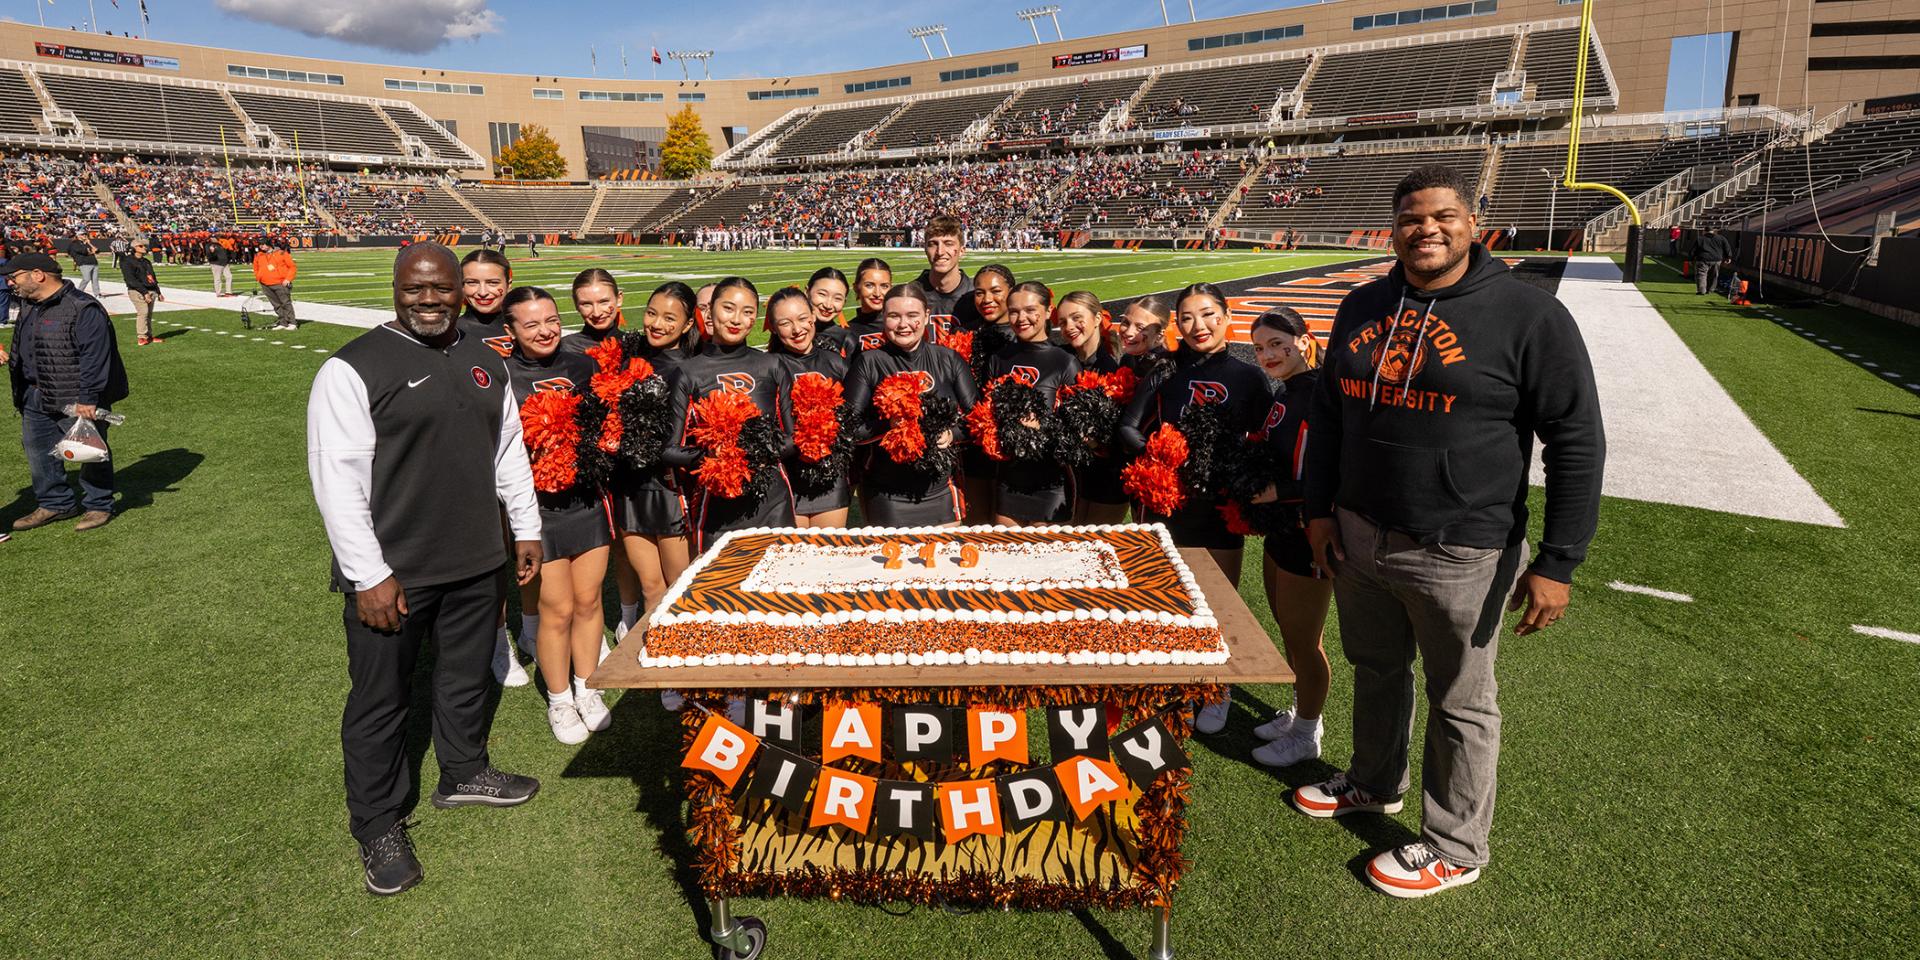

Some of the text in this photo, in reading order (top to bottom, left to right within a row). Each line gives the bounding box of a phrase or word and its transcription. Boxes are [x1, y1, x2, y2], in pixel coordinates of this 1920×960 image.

[1752, 235, 1826, 283] PRINCETON
[1348, 309, 1467, 368] PRINCETON
[1340, 377, 1457, 413] UNIVERSITY
[753, 698, 1099, 751] HAPPY
[700, 724, 1166, 830] BIRTHDAY
